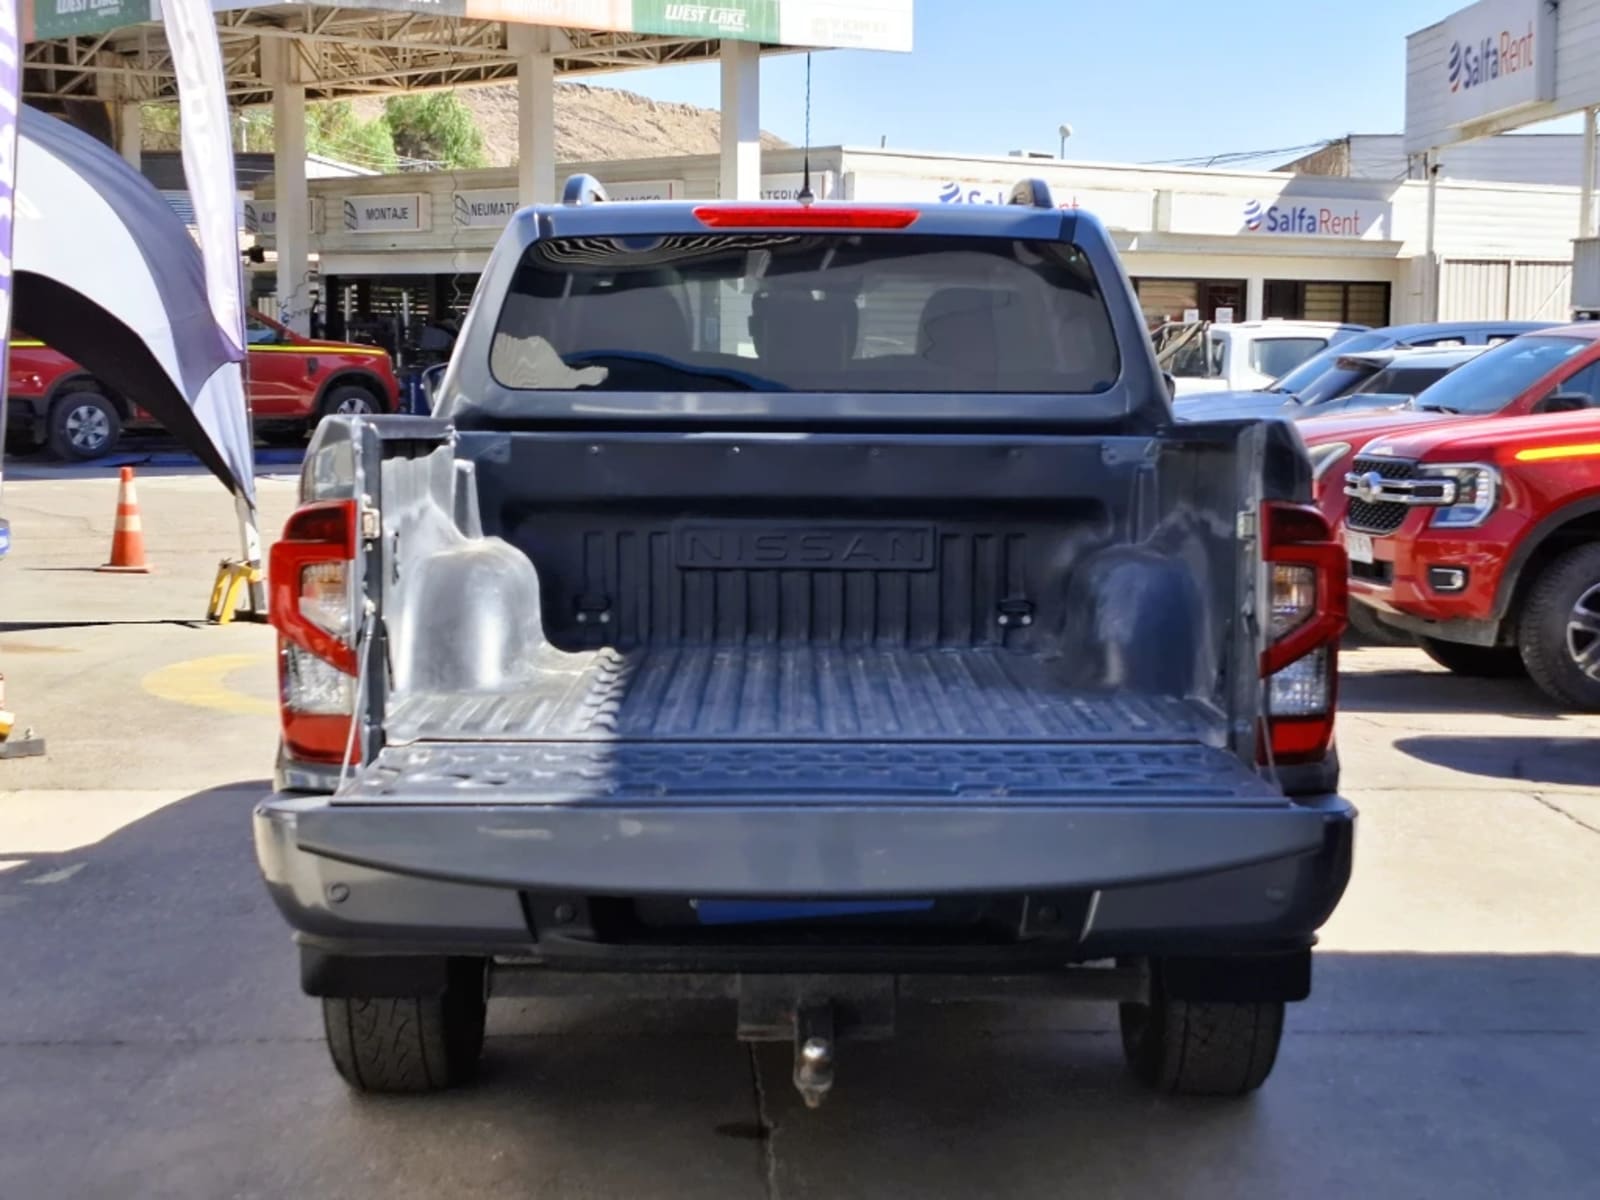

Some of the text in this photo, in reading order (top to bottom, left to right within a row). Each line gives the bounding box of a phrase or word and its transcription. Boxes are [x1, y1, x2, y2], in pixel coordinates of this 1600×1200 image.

[665, 4, 746, 26] WEST LAKE
[1463, 21, 1534, 90] SalfaRent
[366, 207, 409, 220] MONTAJE
[471, 202, 519, 217] NEUMATI
[1266, 205, 1361, 236] SalfaRent
[688, 534, 926, 563] NISSAN
